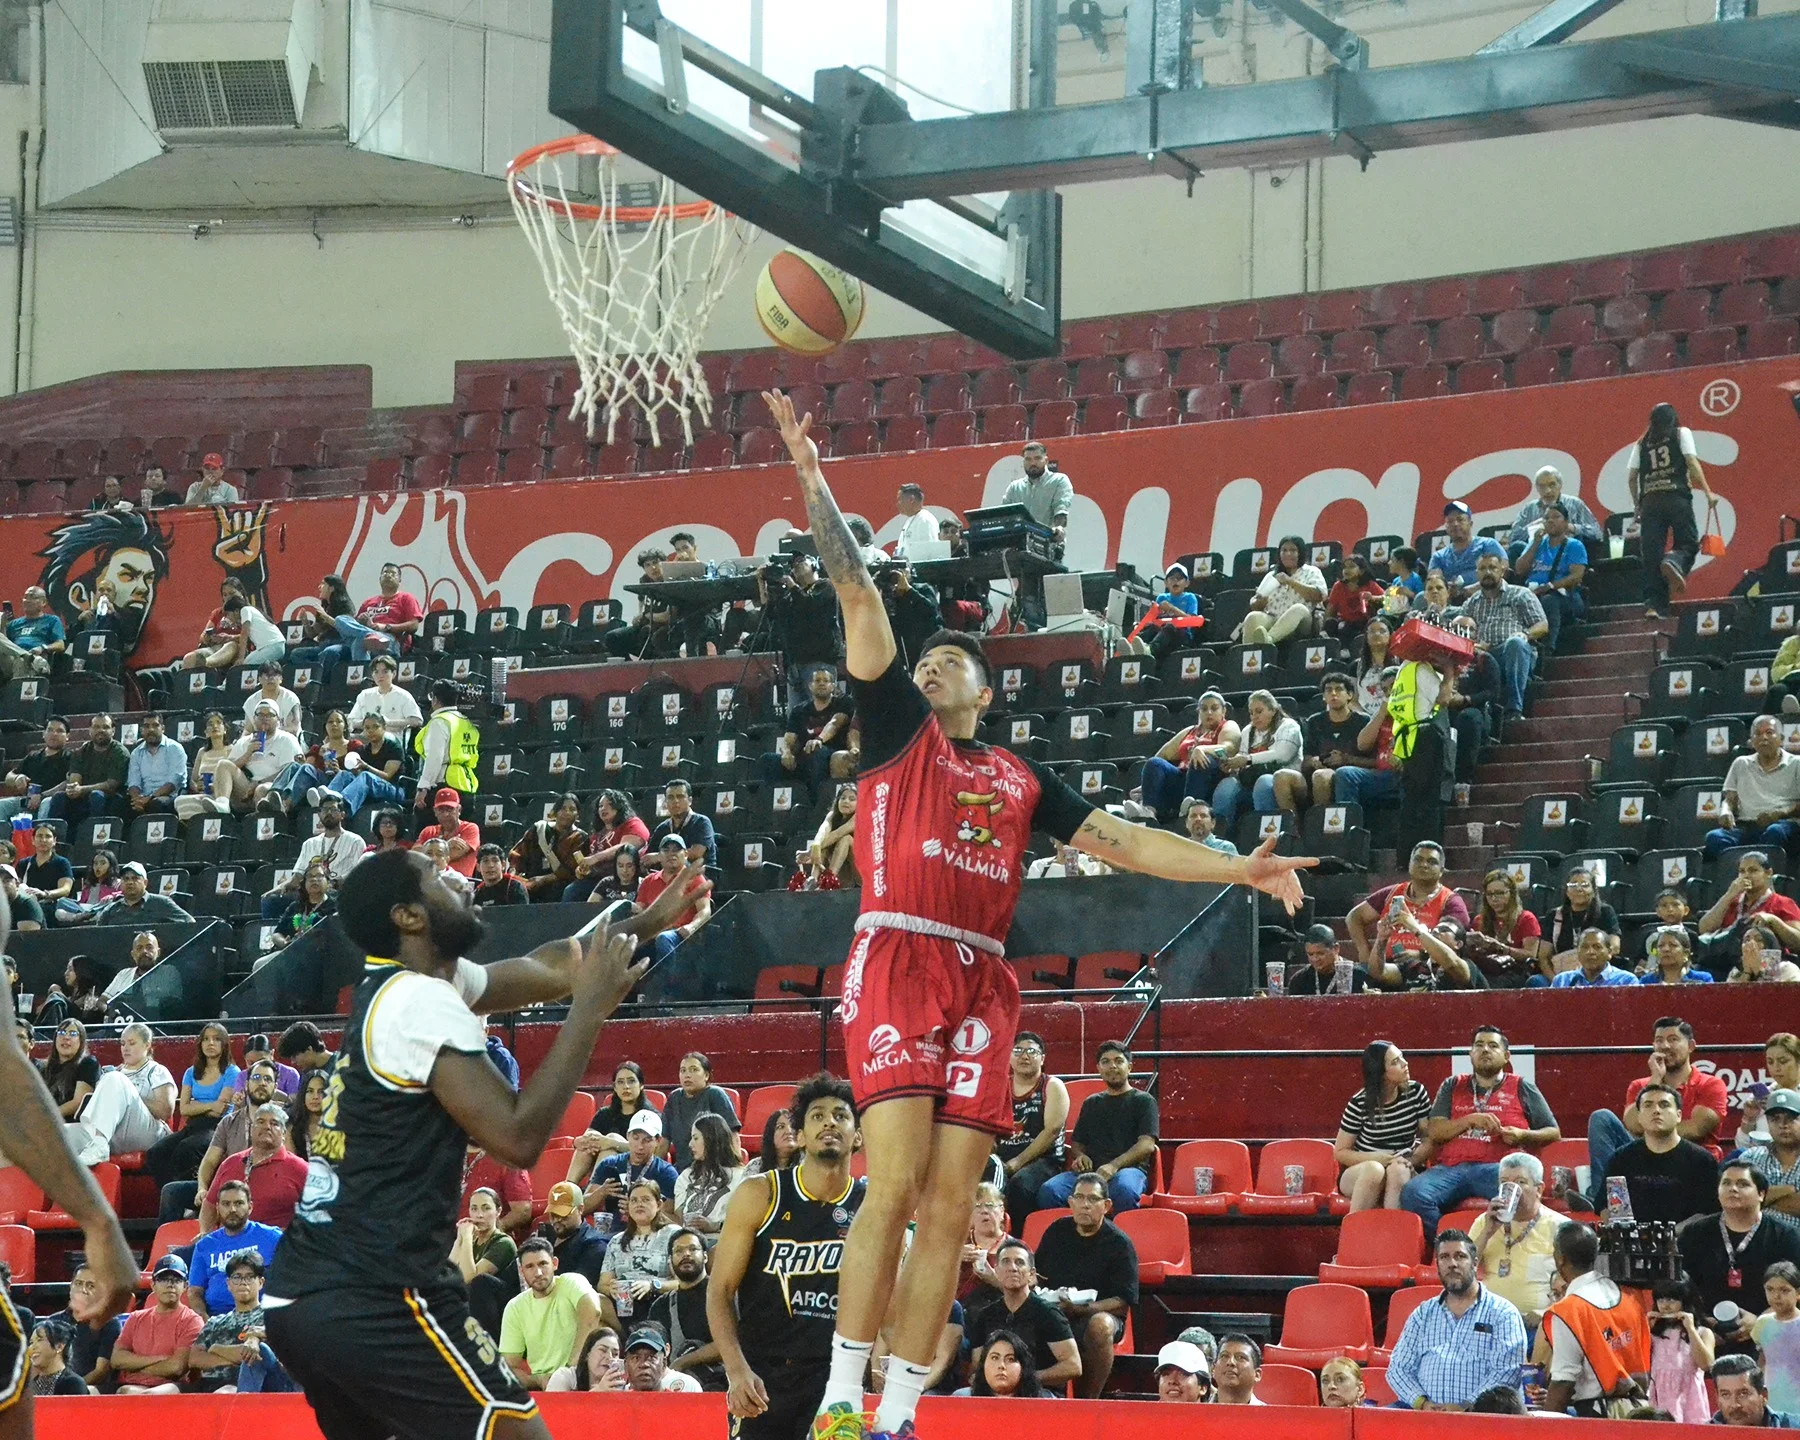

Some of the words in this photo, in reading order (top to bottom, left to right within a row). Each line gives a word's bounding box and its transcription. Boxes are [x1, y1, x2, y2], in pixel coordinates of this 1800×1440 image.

[769, 304, 790, 329] FIBA
[1648, 445, 1671, 470] 13
[1006, 692, 1017, 702] 9G
[1064, 688, 1076, 698] 8G
[552, 722, 567, 732] 17G
[609, 718, 624, 728] 16G
[664, 715, 679, 725] 15G
[952, 842, 1007, 866] GRUPO
[943, 847, 1010, 885] VALMUR
[862, 1048, 913, 1077] MEGA
